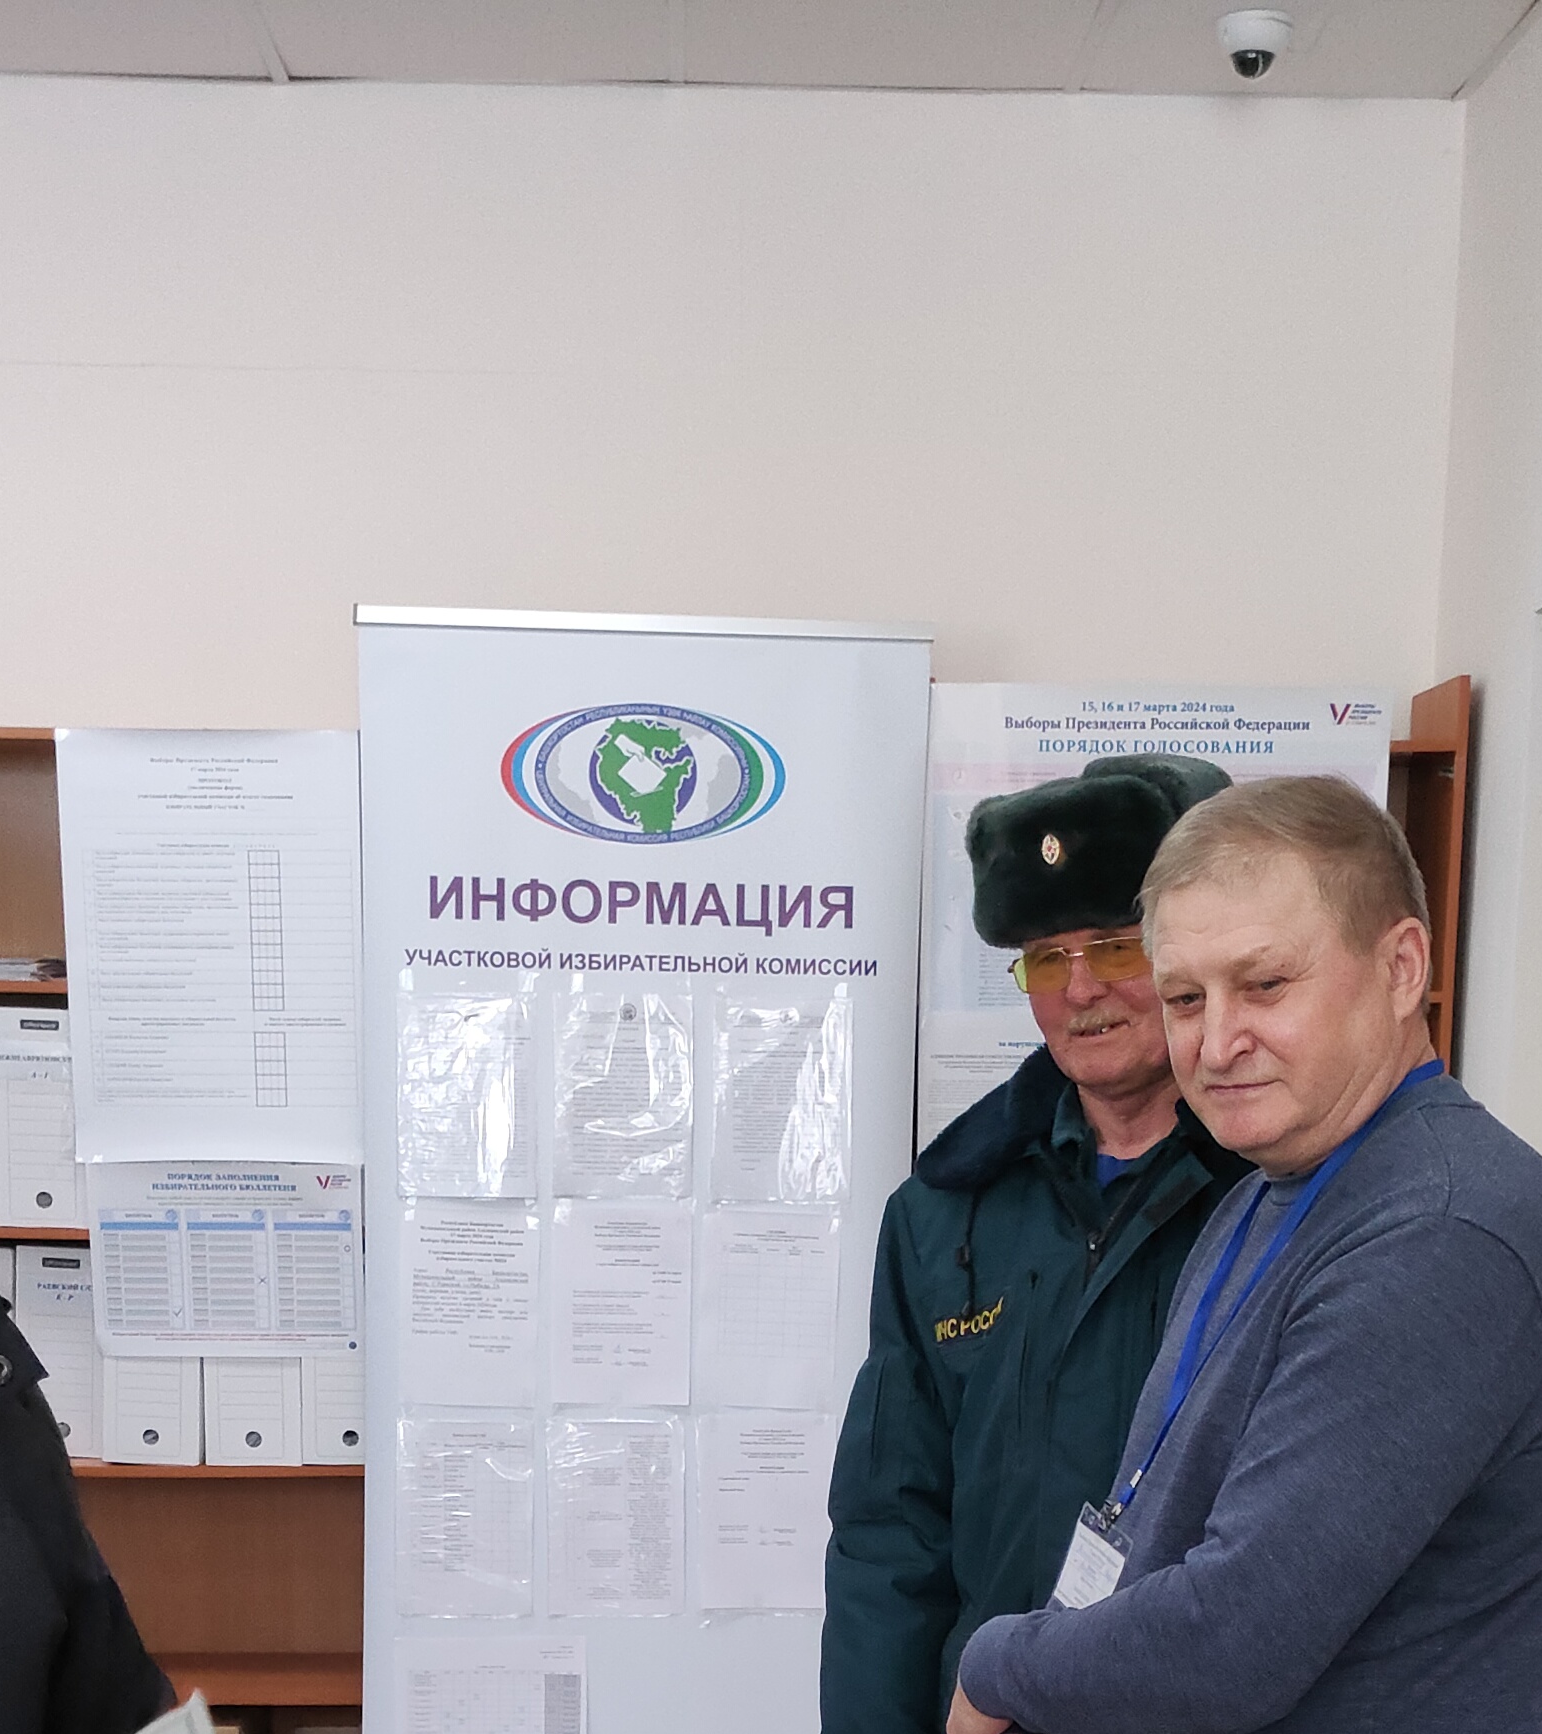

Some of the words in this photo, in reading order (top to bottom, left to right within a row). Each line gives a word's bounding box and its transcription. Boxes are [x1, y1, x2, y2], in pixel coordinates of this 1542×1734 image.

[1082, 702, 1099, 714] 15,
[1101, 702, 1114, 712] 16
[1128, 702, 1140, 712] 17
[1143, 704, 1178, 715] марта
[1180, 702, 1207, 713] 2024
[1209, 704, 1235, 715] года
[1004, 717, 1061, 733] Выборы
[1065, 717, 1146, 733] Президента
[1150, 717, 1230, 731] Российской
[1234, 718, 1310, 734] Федерации
[1038, 739, 1127, 754] ПОРЯДОК
[1133, 740, 1275, 754] ГОЛОСОВАНИЯ
[428, 876, 854, 936] ИНФОРМАЦИЯ
[404, 947, 552, 970] УЧАСТКОВОЙ
[559, 952, 749, 975] ИЗБИРАТЕЛЬНОЙ
[755, 958, 878, 977] КОМИССИИ
